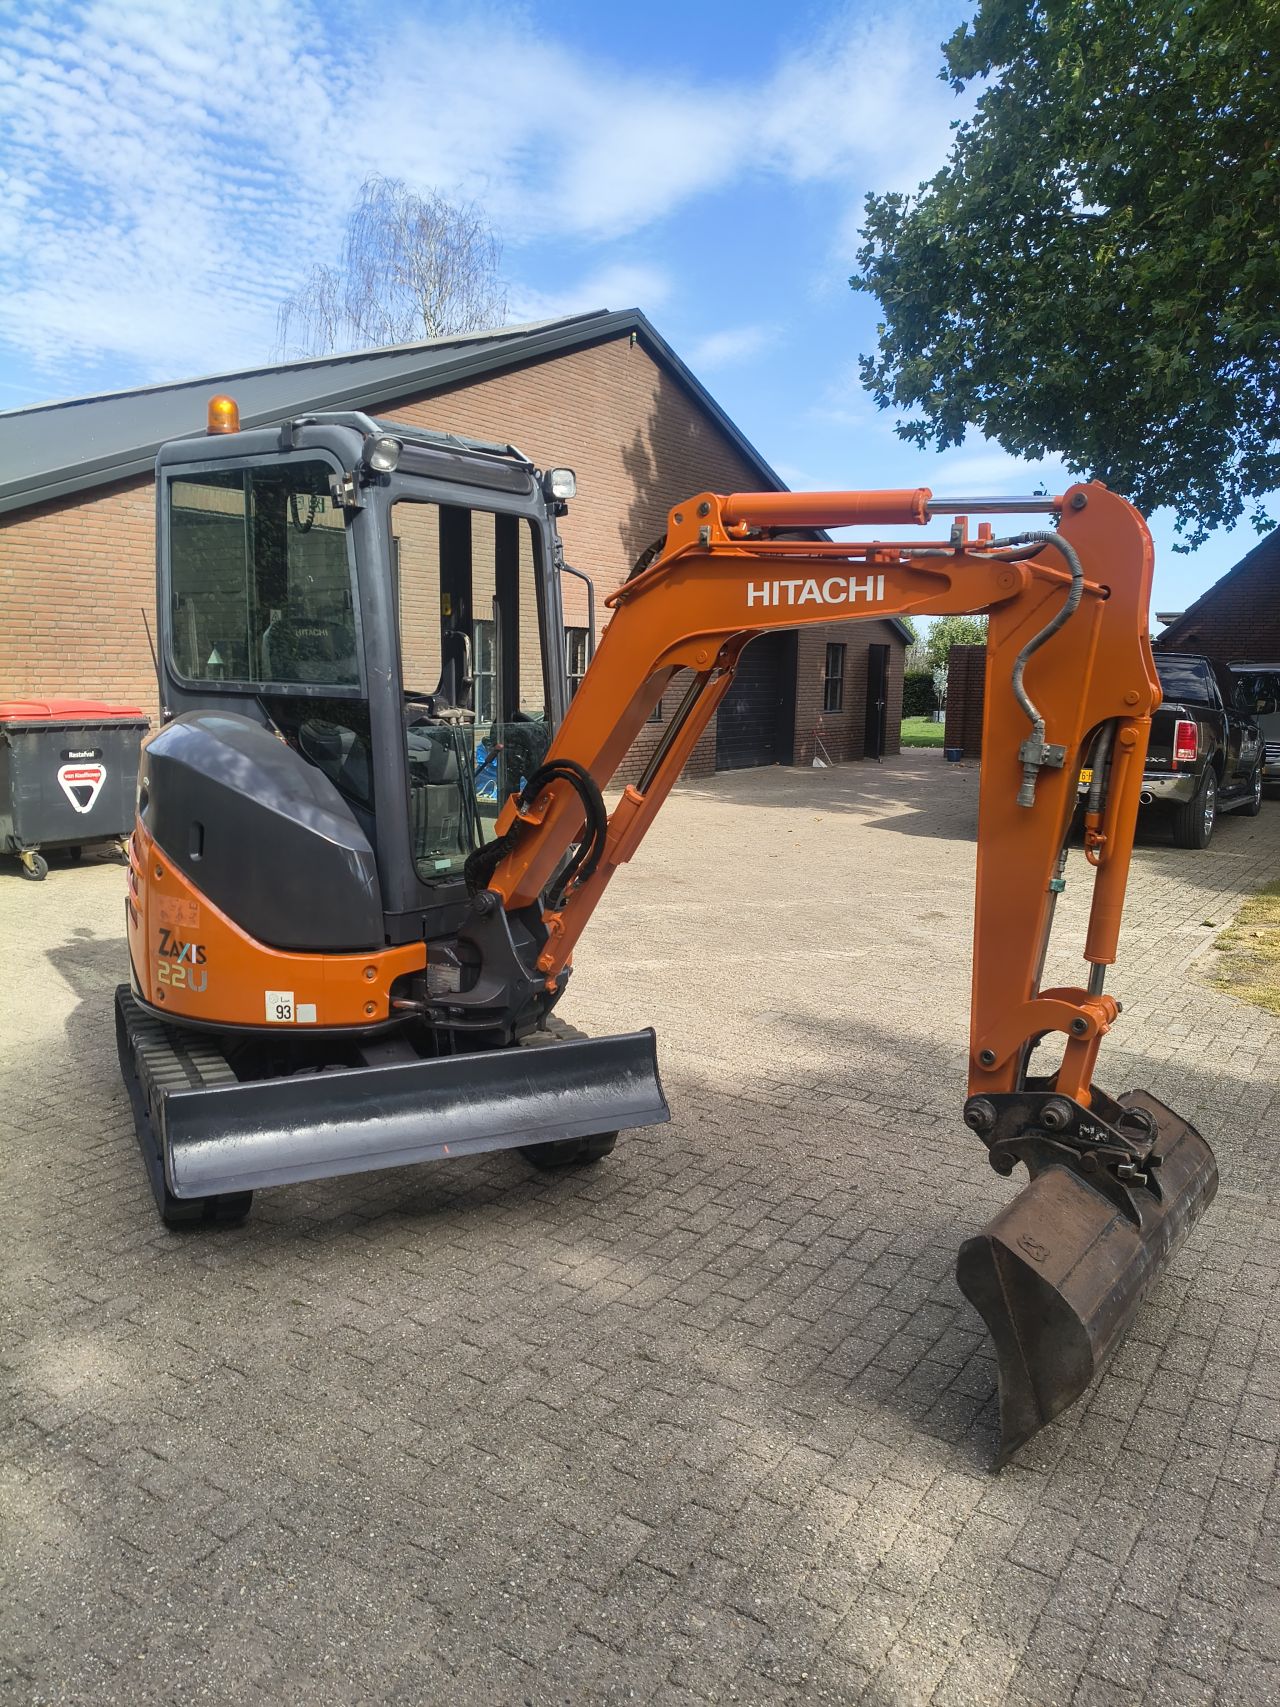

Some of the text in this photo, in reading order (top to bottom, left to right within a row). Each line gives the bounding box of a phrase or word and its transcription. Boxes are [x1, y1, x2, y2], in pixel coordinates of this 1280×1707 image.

[747, 574, 885, 607] HITACHI
[295, 628, 328, 637] HITACHI
[158, 927, 207, 965] ZAXIS
[158, 959, 208, 992] 22U
[276, 1004, 292, 1020] 93
